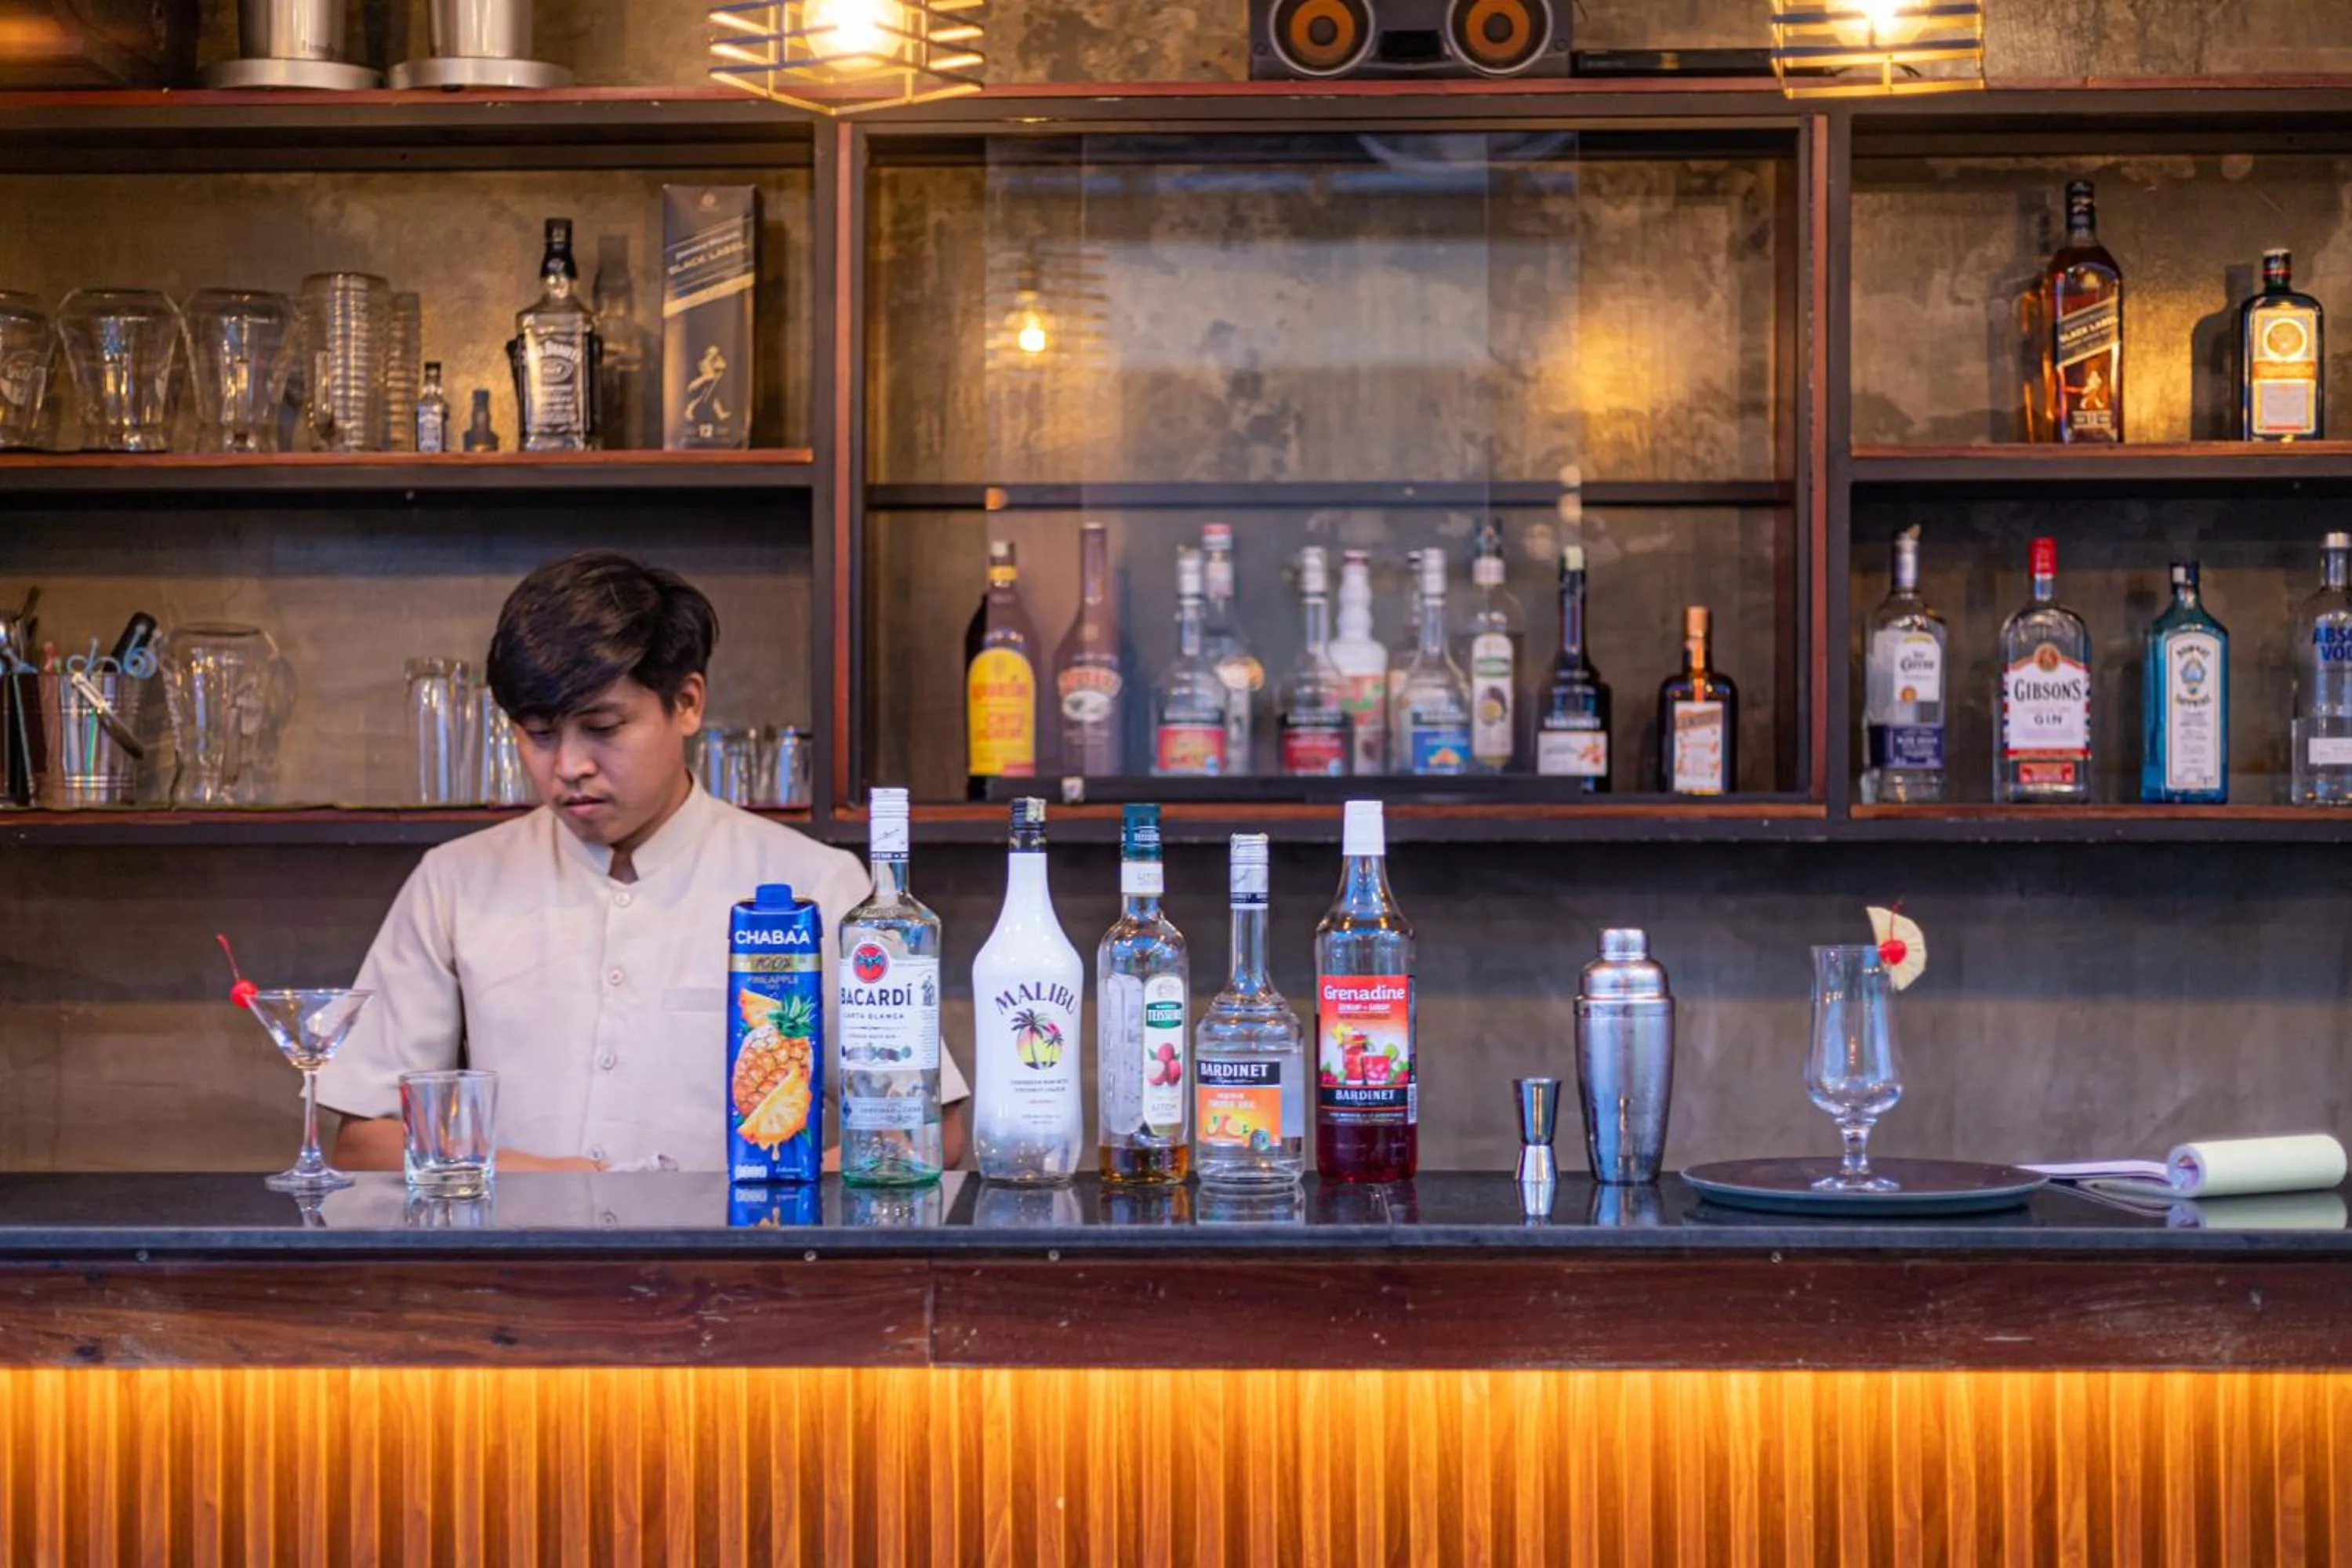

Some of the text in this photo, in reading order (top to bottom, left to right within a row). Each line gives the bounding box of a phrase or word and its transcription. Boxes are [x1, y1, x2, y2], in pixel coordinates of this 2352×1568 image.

[2033, 713, 2063, 726] GIN
[995, 981, 1077, 1014] MALIBU
[1323, 984, 1406, 1001] Grenadine
[1200, 1062, 1269, 1076] BARDINET
[1335, 1089, 1395, 1100] BARDINET
